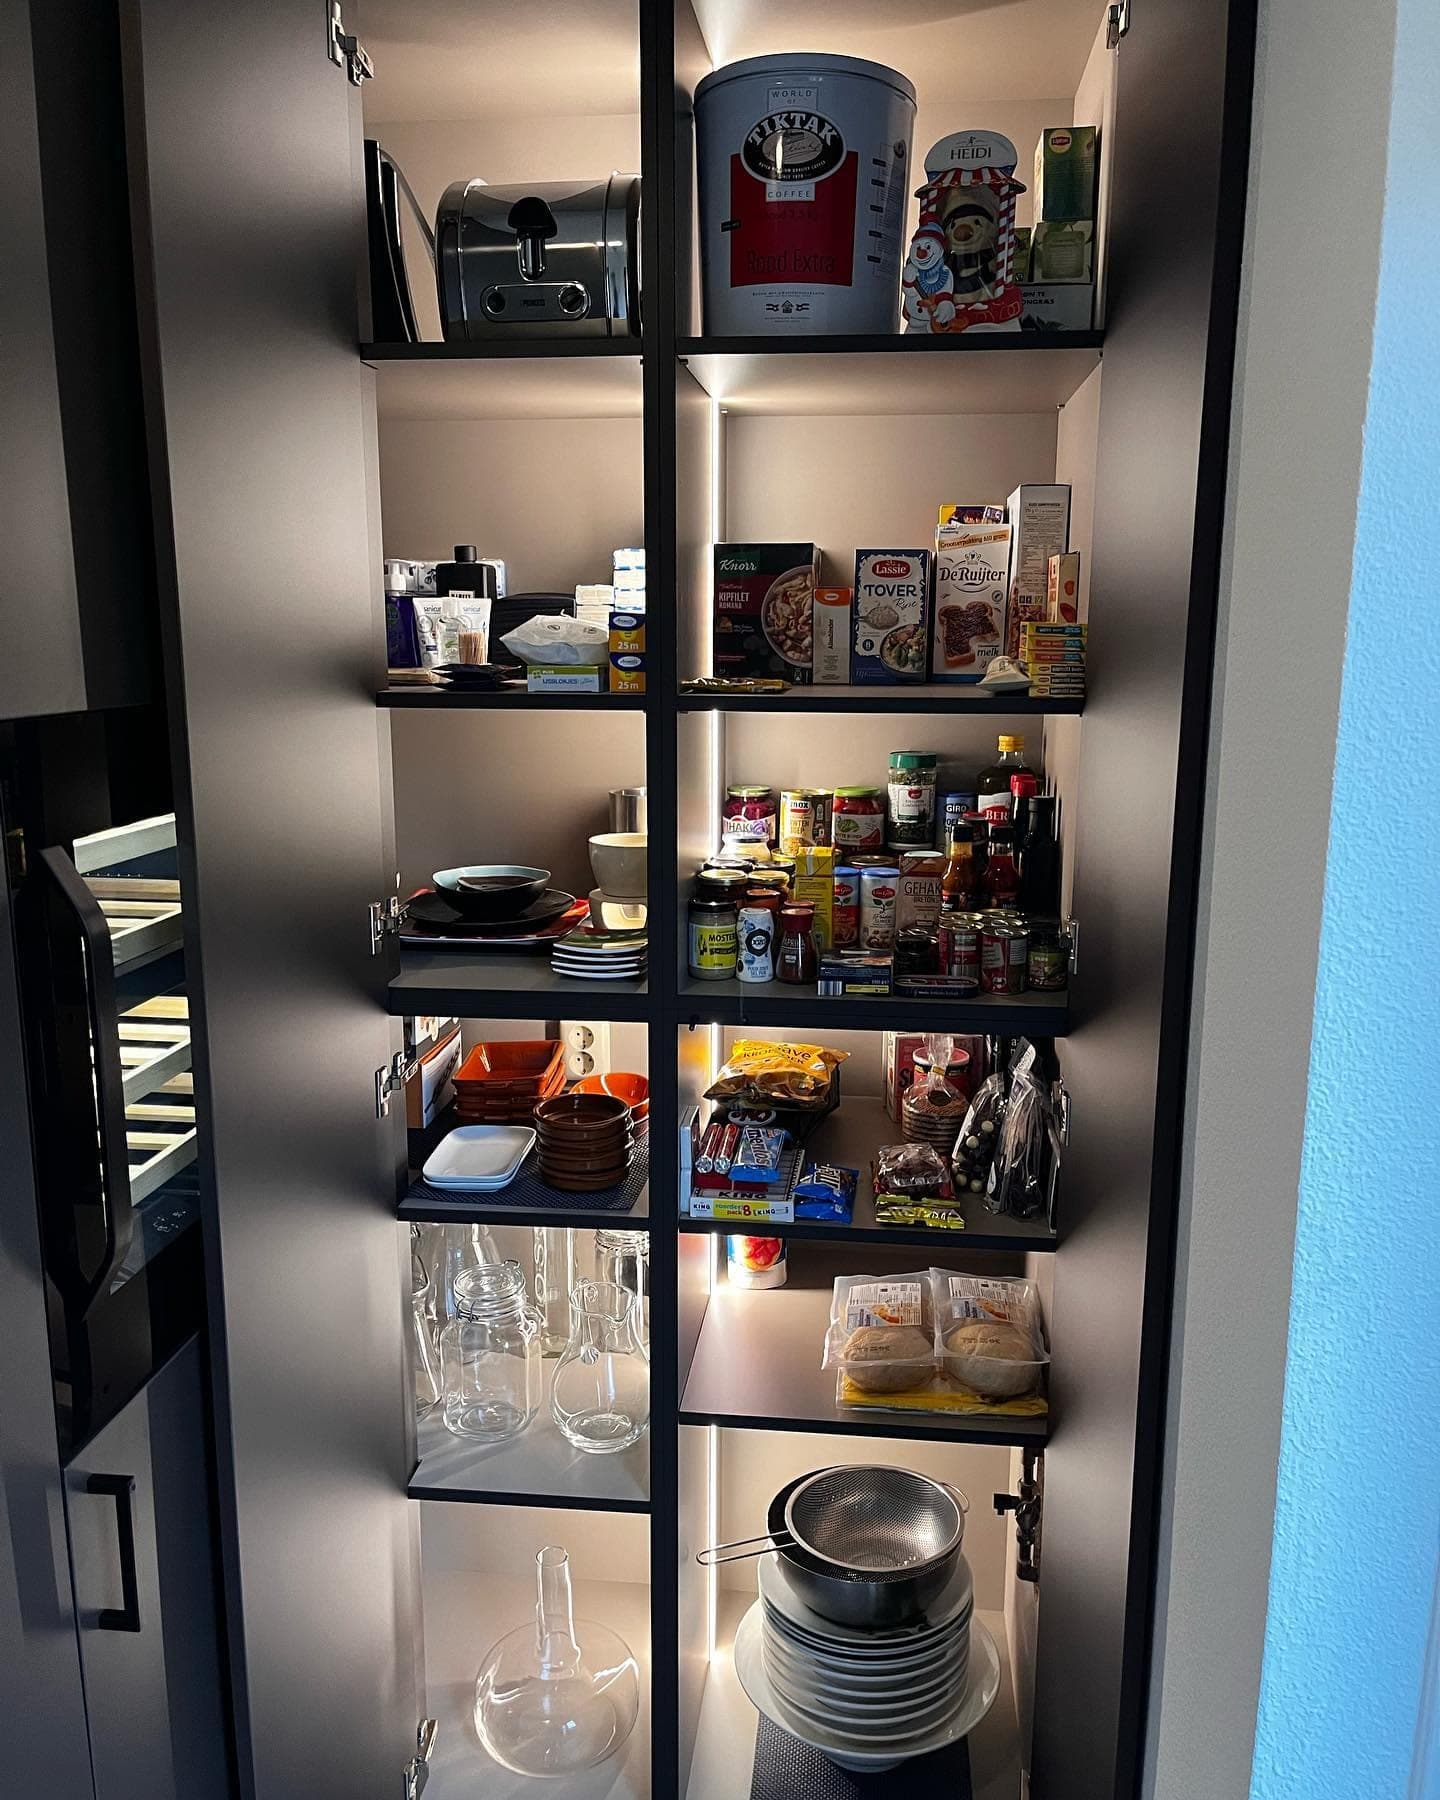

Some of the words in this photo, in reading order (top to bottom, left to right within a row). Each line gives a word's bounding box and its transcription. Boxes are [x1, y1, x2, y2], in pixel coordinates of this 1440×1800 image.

[771, 90, 812, 98] WORLD
[747, 112, 838, 147] TIKTAK
[950, 147, 992, 160] HEIDI
[767, 190, 810, 199] COFFEE
[719, 559, 757, 571] Knorr
[875, 562, 908, 575] Lassie
[718, 591, 750, 602] KIPFILET
[863, 583, 917, 597] TOVER
[746, 1129, 770, 1166] mentos
[718, 1191, 767, 1199] KING
[742, 1204, 752, 1217] 8
